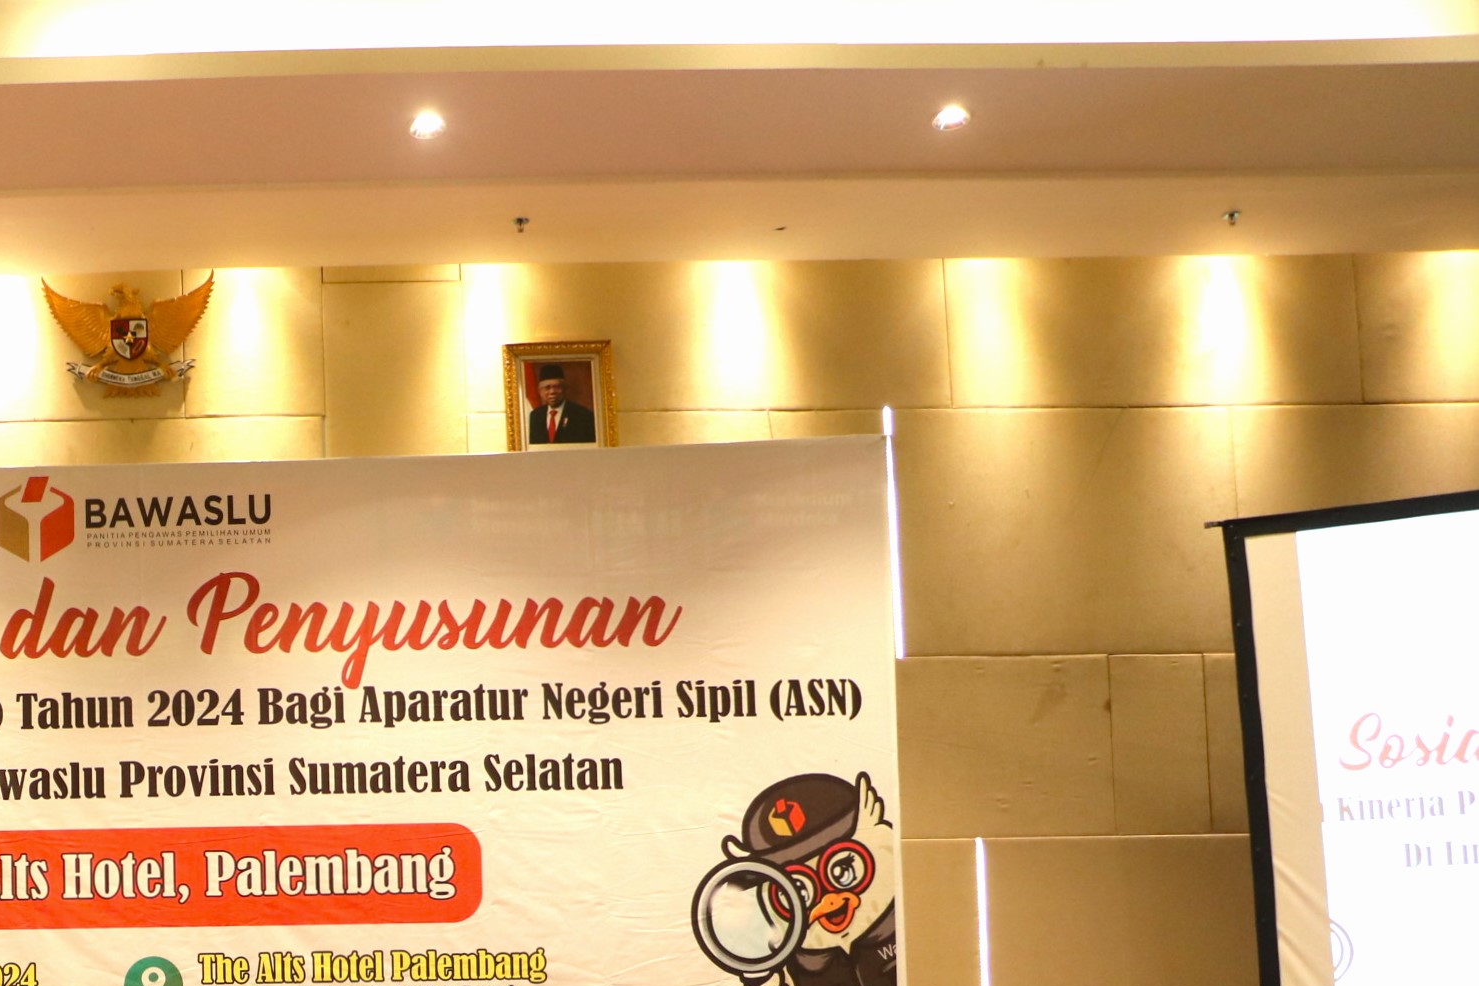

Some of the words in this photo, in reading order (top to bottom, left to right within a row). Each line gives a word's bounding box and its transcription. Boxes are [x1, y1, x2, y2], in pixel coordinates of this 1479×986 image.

[85, 493, 272, 529] BAWASLU
[86, 531, 126, 540] PANITIA
[128, 530, 183, 539] PENGAWAS
[185, 528, 240, 538] PEMILIHAN
[242, 528, 272, 537] UMUM
[86, 540, 146, 549] PROVINSI
[150, 538, 215, 548] SUMATERA
[218, 536, 272, 546] SELATAN
[0, 576, 168, 661] dan
[187, 571, 683, 690] Penyusunan
[15, 691, 134, 730] Tahun
[147, 688, 245, 728] 2024
[257, 685, 346, 730] Bagi
[359, 684, 530, 728] Aparatur
[541, 680, 664, 725] Negeri
[675, 679, 757, 723] Sipil
[769, 678, 863, 722] (ASN)
[119, 757, 276, 799] Provinsi
[288, 755, 471, 796] Sumatera
[483, 753, 624, 792] Selatan
[60, 850, 192, 906] Hotel,
[203, 845, 458, 901] Palembang
[198, 953, 250, 984] The
[256, 951, 305, 983] Alts
[311, 950, 385, 982] Hotel
[391, 947, 547, 983] Palembang
